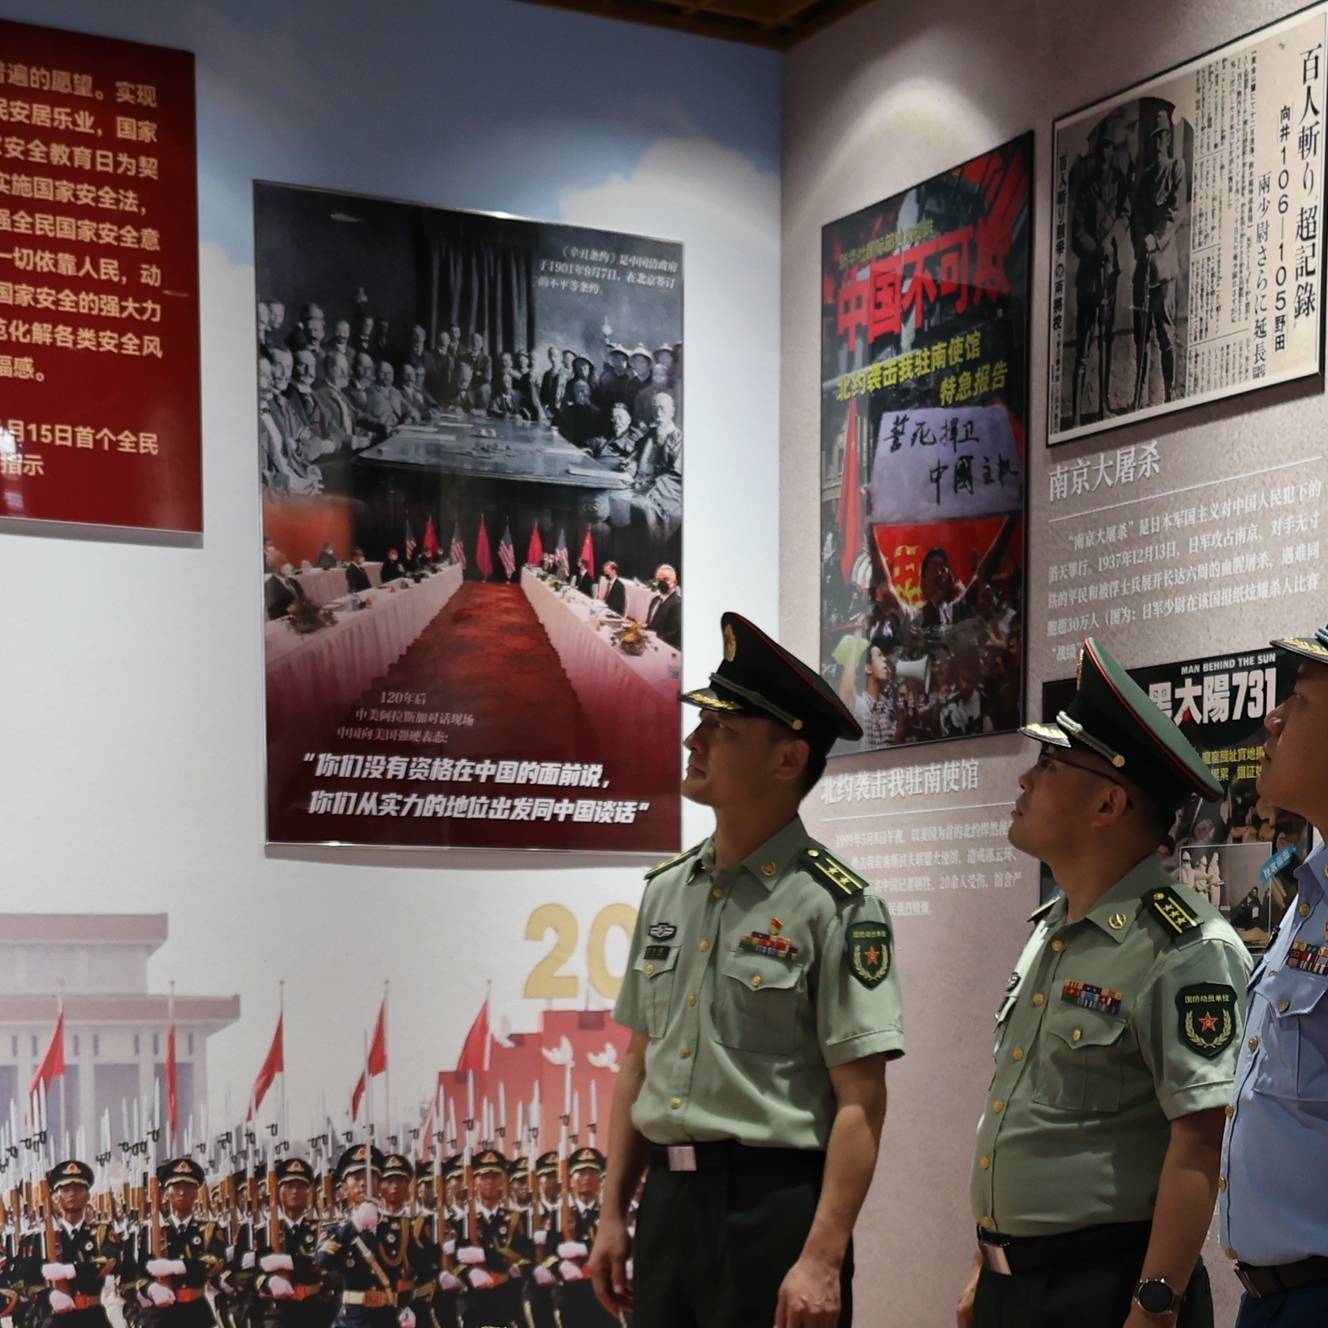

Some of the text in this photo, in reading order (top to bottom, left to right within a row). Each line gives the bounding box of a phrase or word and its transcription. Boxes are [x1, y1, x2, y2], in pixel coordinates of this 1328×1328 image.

[939, 360, 1008, 406] 特急报告
[1049, 440, 1161, 501] 南京大屠杀
[1181, 652, 1276, 676] MAN BEHIND THE SUN
[821, 758, 980, 806] 北约袭击我驻南使馆
